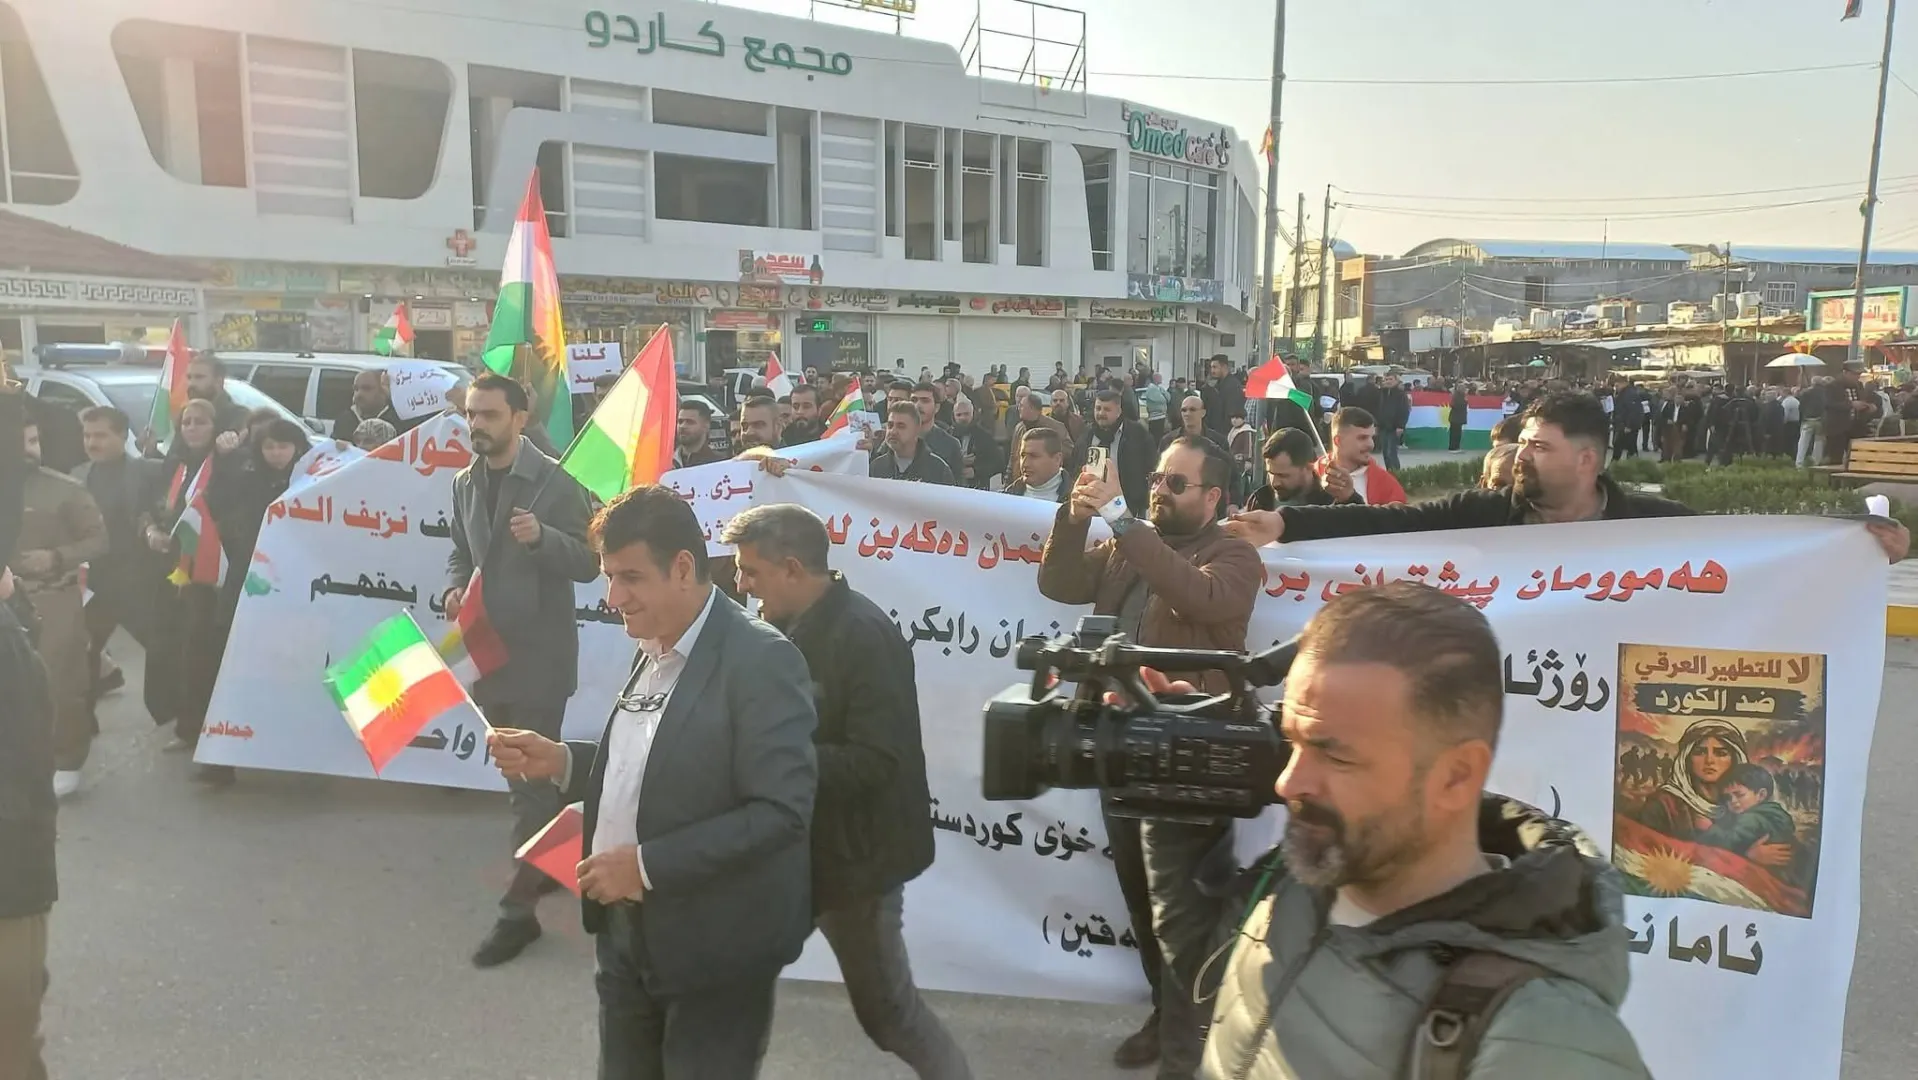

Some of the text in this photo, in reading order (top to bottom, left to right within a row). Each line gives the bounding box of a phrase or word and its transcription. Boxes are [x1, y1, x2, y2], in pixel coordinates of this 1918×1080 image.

[584, 10, 853, 82] مجمع كاردو
[1127, 110, 1188, 159] Omed
[269, 495, 333, 525] الدم
[343, 500, 408, 538] نزيف
[310, 572, 418, 609] بحقهم
[1503, 648, 1611, 713] رۆژئا
[1634, 651, 1811, 684] لا للتطهير العرقي
[1735, 690, 1776, 714] ضد
[407, 723, 477, 761] واح
[1626, 912, 1764, 976] ئامان
